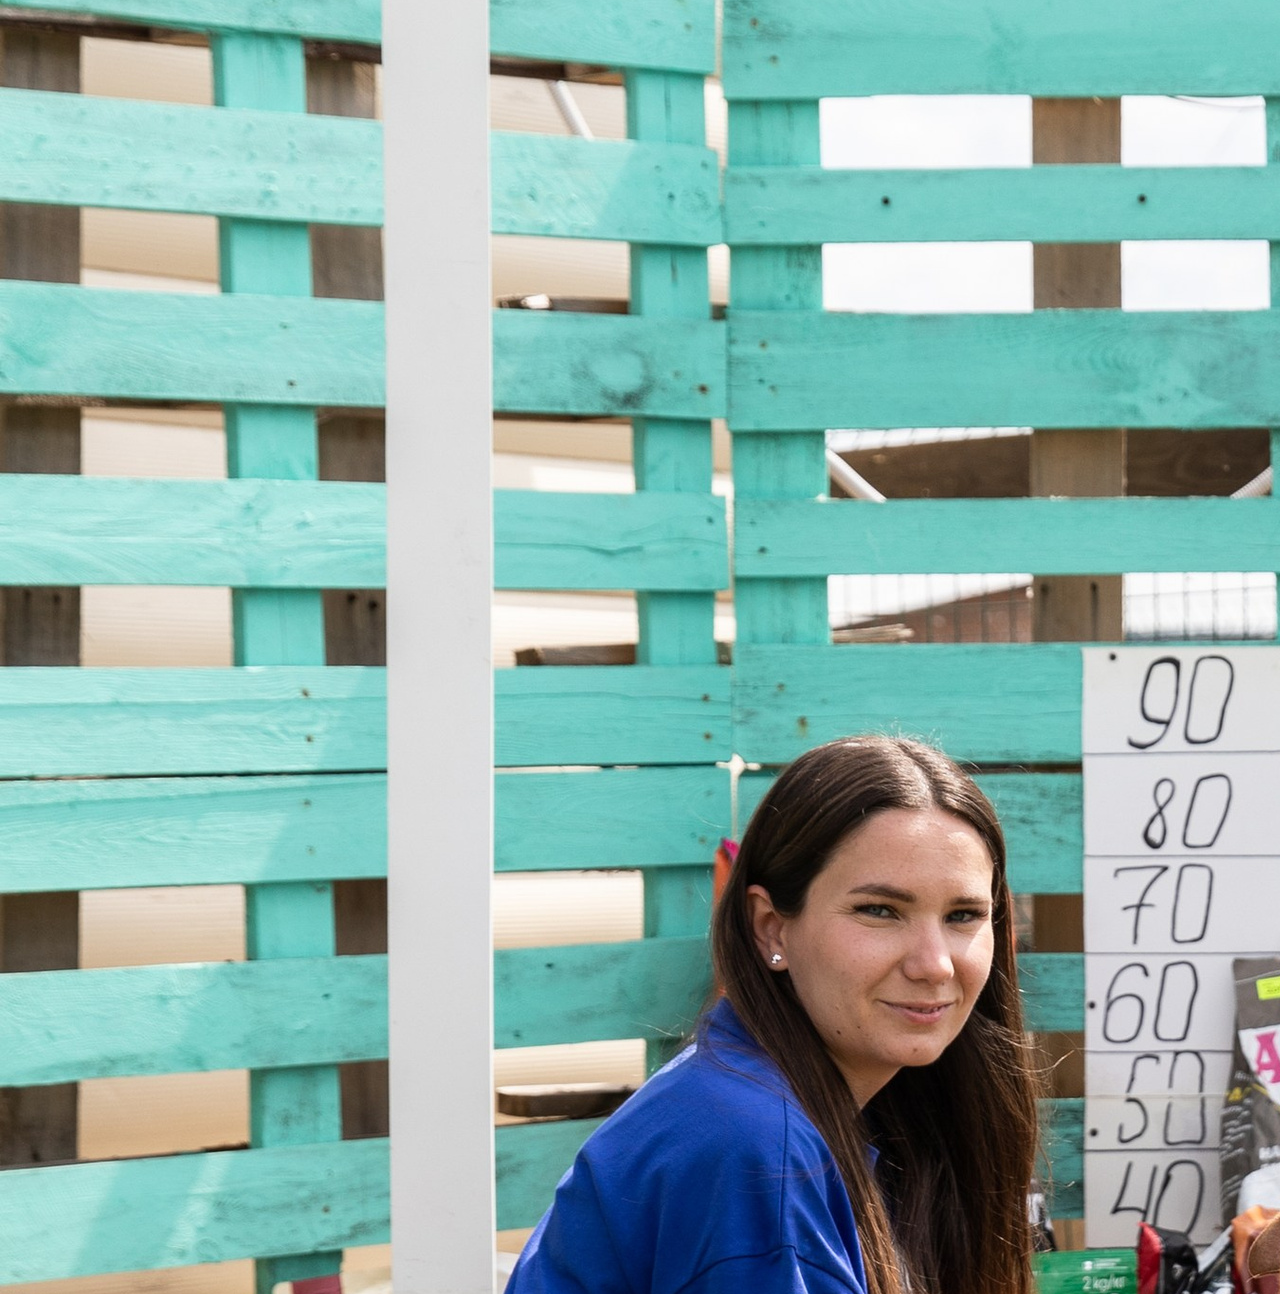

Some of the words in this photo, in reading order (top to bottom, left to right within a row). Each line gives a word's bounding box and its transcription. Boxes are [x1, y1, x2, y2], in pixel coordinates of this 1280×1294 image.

[1127, 655, 1235, 750] 90
[1142, 772, 1233, 849] 80
[1113, 863, 1214, 945] 70
[1102, 960, 1199, 1044] 60
[1118, 1050, 1207, 1145] 50
[1110, 1159, 1206, 1236] 40
